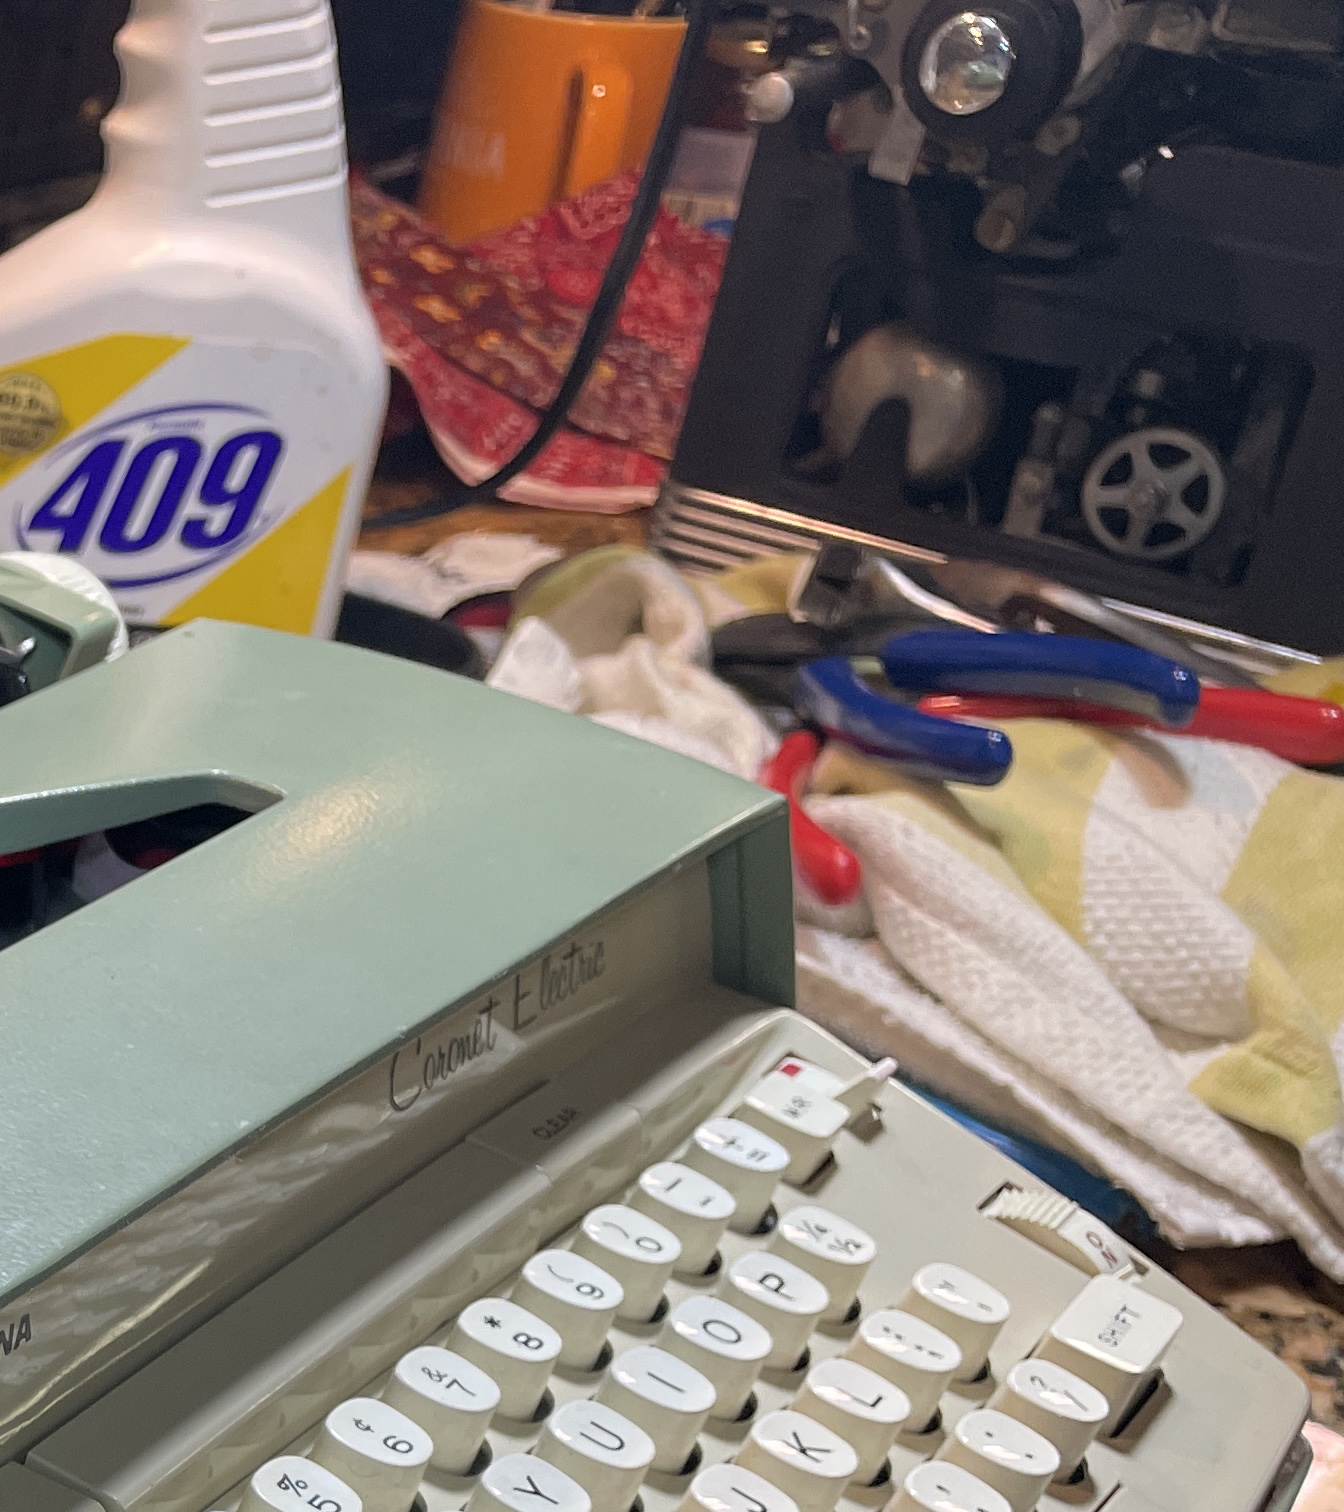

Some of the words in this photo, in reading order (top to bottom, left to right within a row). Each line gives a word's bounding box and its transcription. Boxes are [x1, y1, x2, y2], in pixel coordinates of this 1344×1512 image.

[28, 431, 282, 554] 409
[388, 996, 502, 1112] Coronet
[575, 1281, 605, 1301] 9
[758, 1272, 797, 1302] P
[512, 1331, 545, 1351] 8
[702, 1318, 743, 1345] O
[421, 1365, 448, 1383] &
[645, 1370, 688, 1395] I
[445, 1378, 477, 1398] 7
[382, 1434, 415, 1455] 6
[578, 1420, 627, 1452] U
[781, 1430, 833, 1464] K
[276, 1472, 309, 1498] %
[512, 1475, 561, 1506] Y
